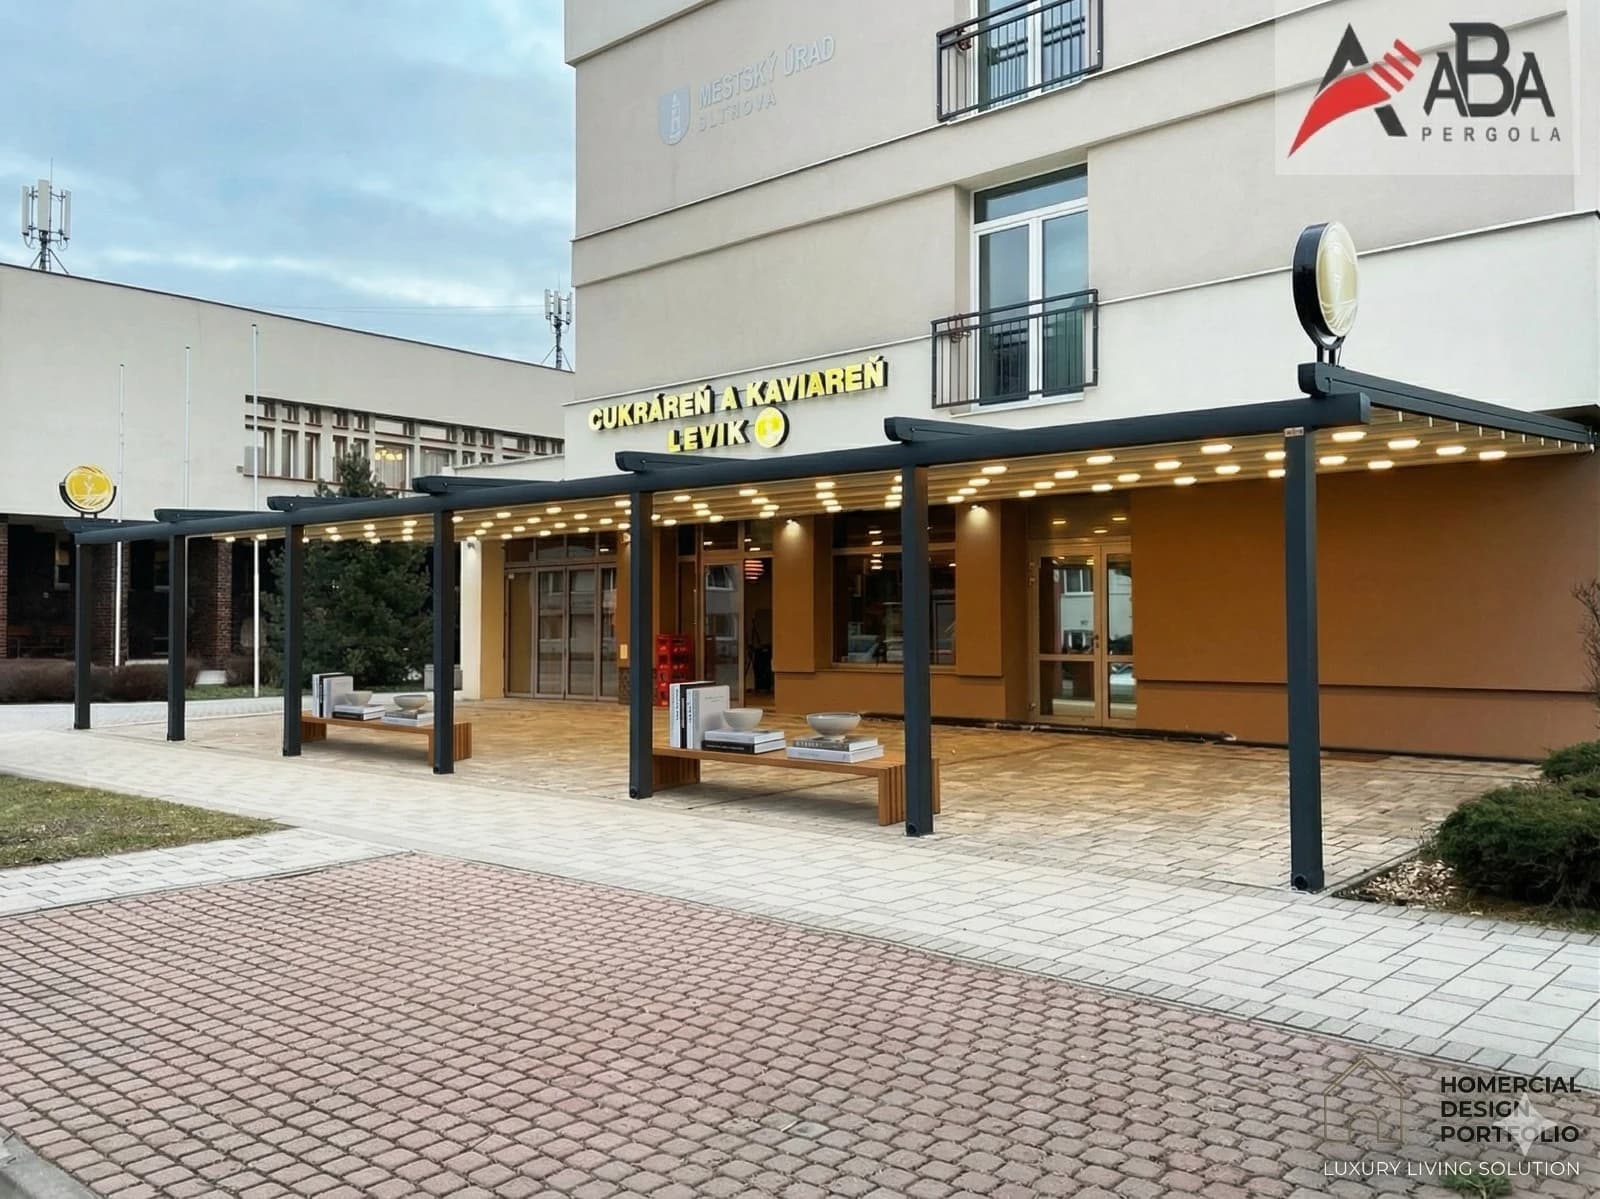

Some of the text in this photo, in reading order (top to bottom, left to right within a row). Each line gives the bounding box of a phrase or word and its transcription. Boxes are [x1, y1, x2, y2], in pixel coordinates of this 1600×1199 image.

[699, 33, 836, 110] MESTSKÝ ÚRAD
[588, 355, 889, 432] CUKRÁREŇ A KAVIAREŇ
[667, 419, 750, 452] LEVIK
